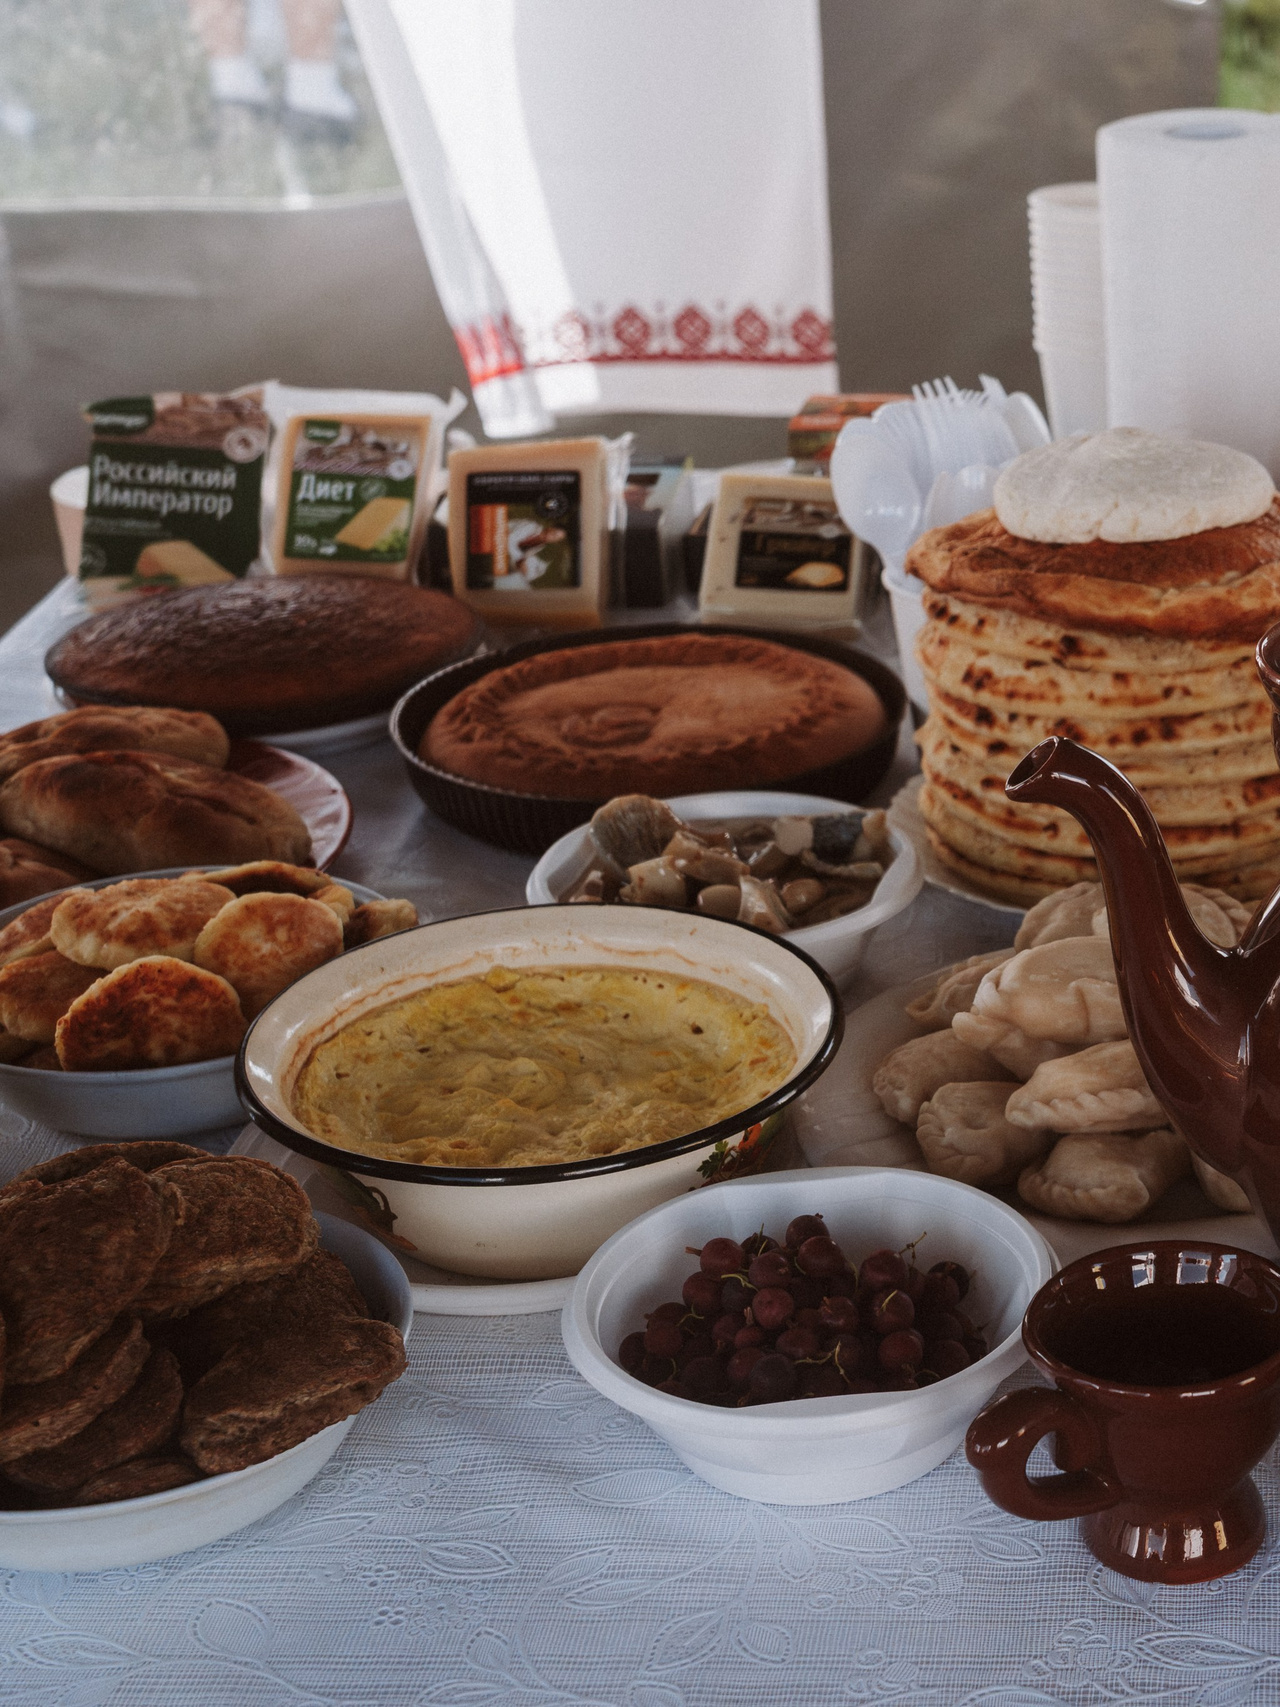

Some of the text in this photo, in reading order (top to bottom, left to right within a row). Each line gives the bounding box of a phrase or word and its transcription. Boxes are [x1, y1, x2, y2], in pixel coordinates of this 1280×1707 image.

[94, 455, 236, 489] Российский
[296, 474, 356, 502] Диет
[94, 482, 233, 520] Император
